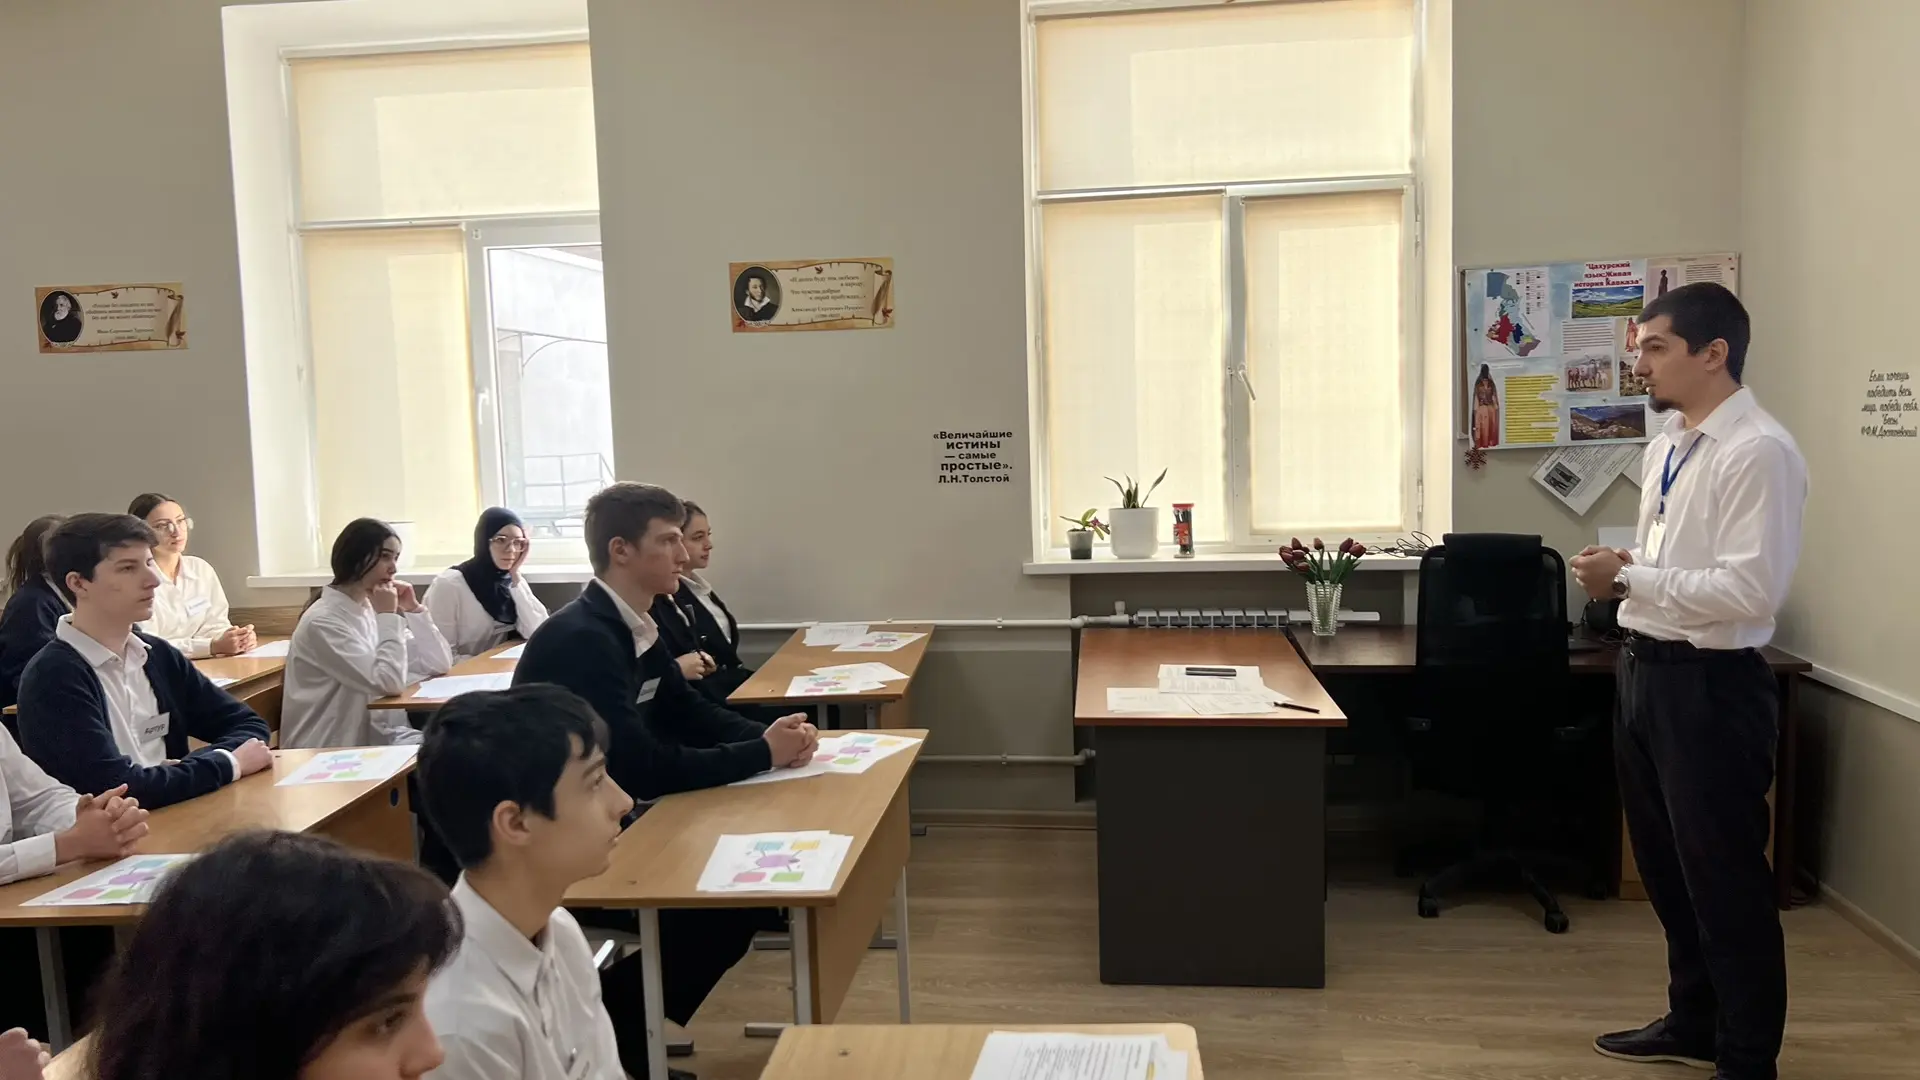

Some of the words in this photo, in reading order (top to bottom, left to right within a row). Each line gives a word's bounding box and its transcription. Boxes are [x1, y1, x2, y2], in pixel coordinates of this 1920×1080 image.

[933, 430, 1013, 439] «Величайшие
[946, 441, 1001, 450] истины
[958, 452, 997, 460] самые
[940, 462, 1013, 473] простые».
[938, 473, 1010, 483] Л.Н.Толстой
